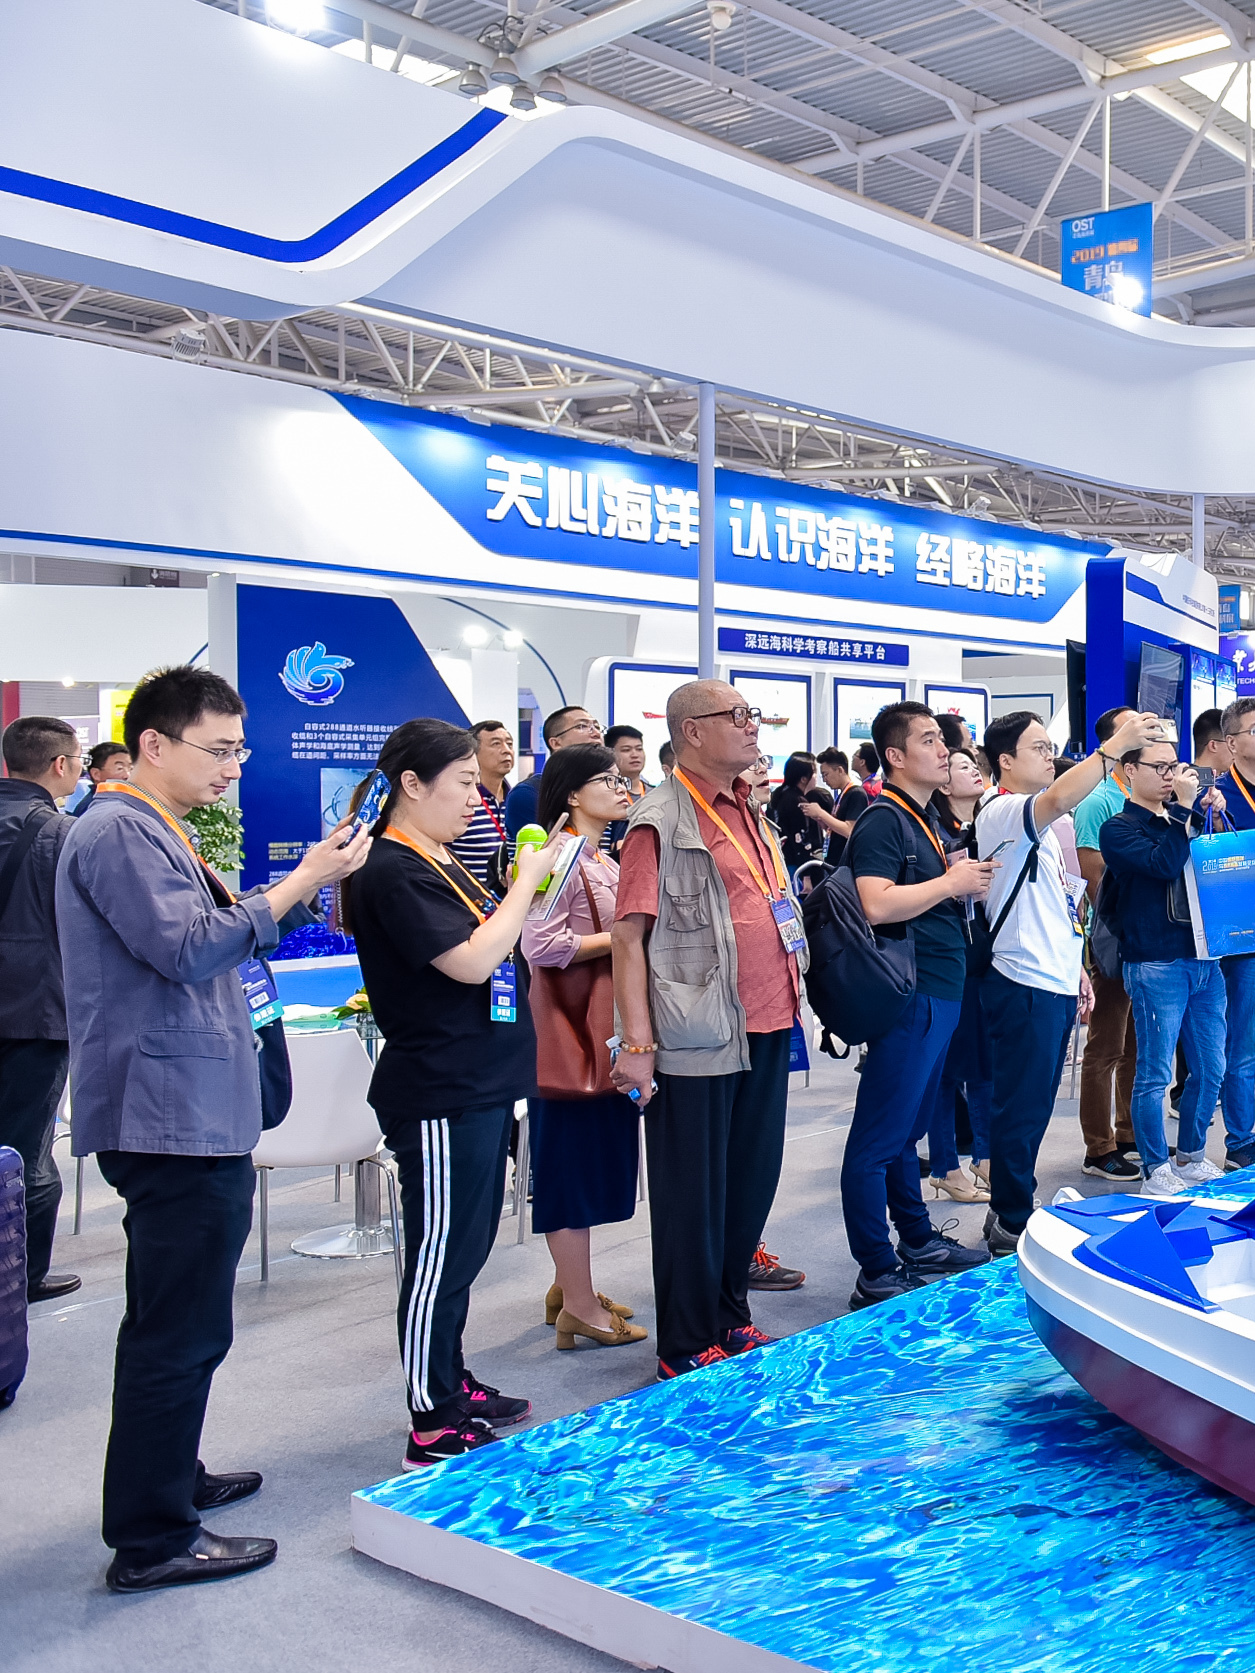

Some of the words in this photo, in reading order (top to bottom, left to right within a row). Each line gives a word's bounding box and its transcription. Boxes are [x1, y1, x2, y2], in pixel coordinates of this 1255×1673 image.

[1072, 216, 1095, 232] OST
[486, 454, 699, 549] 关心海洋
[729, 498, 895, 577] 认识海洋
[915, 532, 1047, 599] 经略海洋
[744, 633, 886, 661] 深远海科学考察船共享平台
